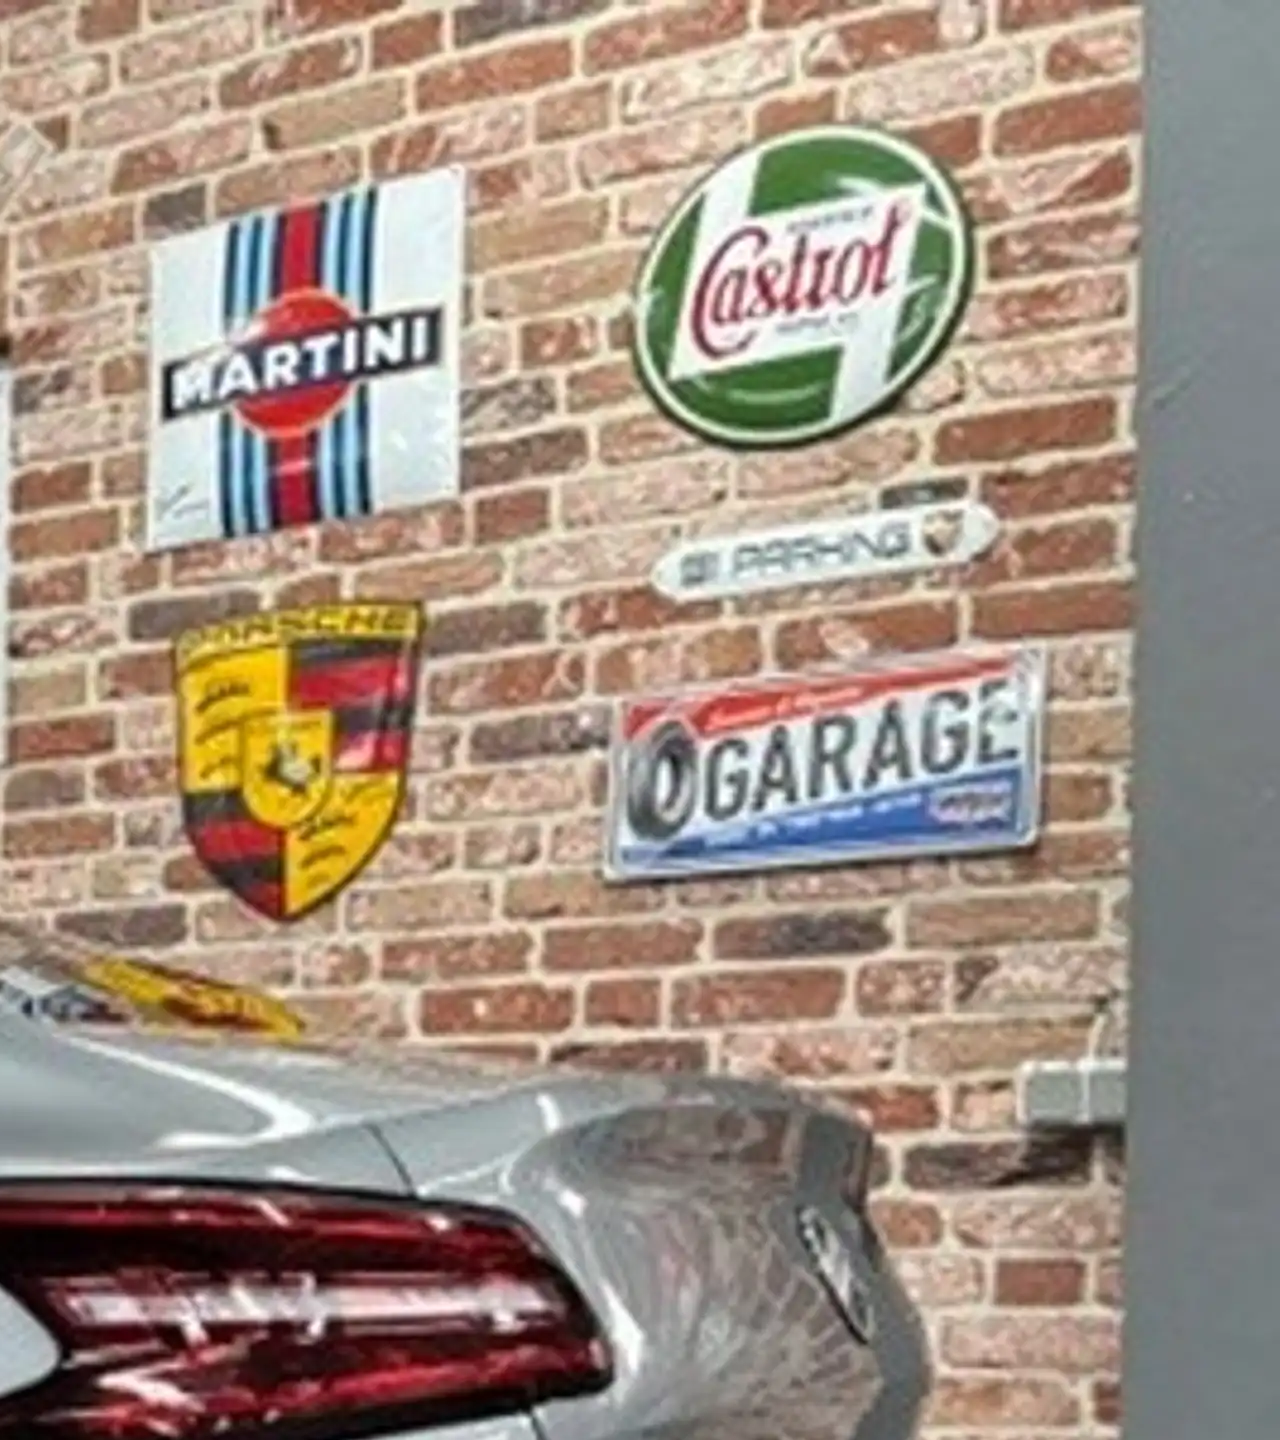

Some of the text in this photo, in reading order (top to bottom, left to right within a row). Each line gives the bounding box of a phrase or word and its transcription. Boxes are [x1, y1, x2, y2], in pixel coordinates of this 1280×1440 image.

[690, 203, 910, 361] Castrol
[170, 316, 431, 410] MARTINI
[734, 522, 913, 574] PARKING
[703, 676, 1020, 822] GARAGE
